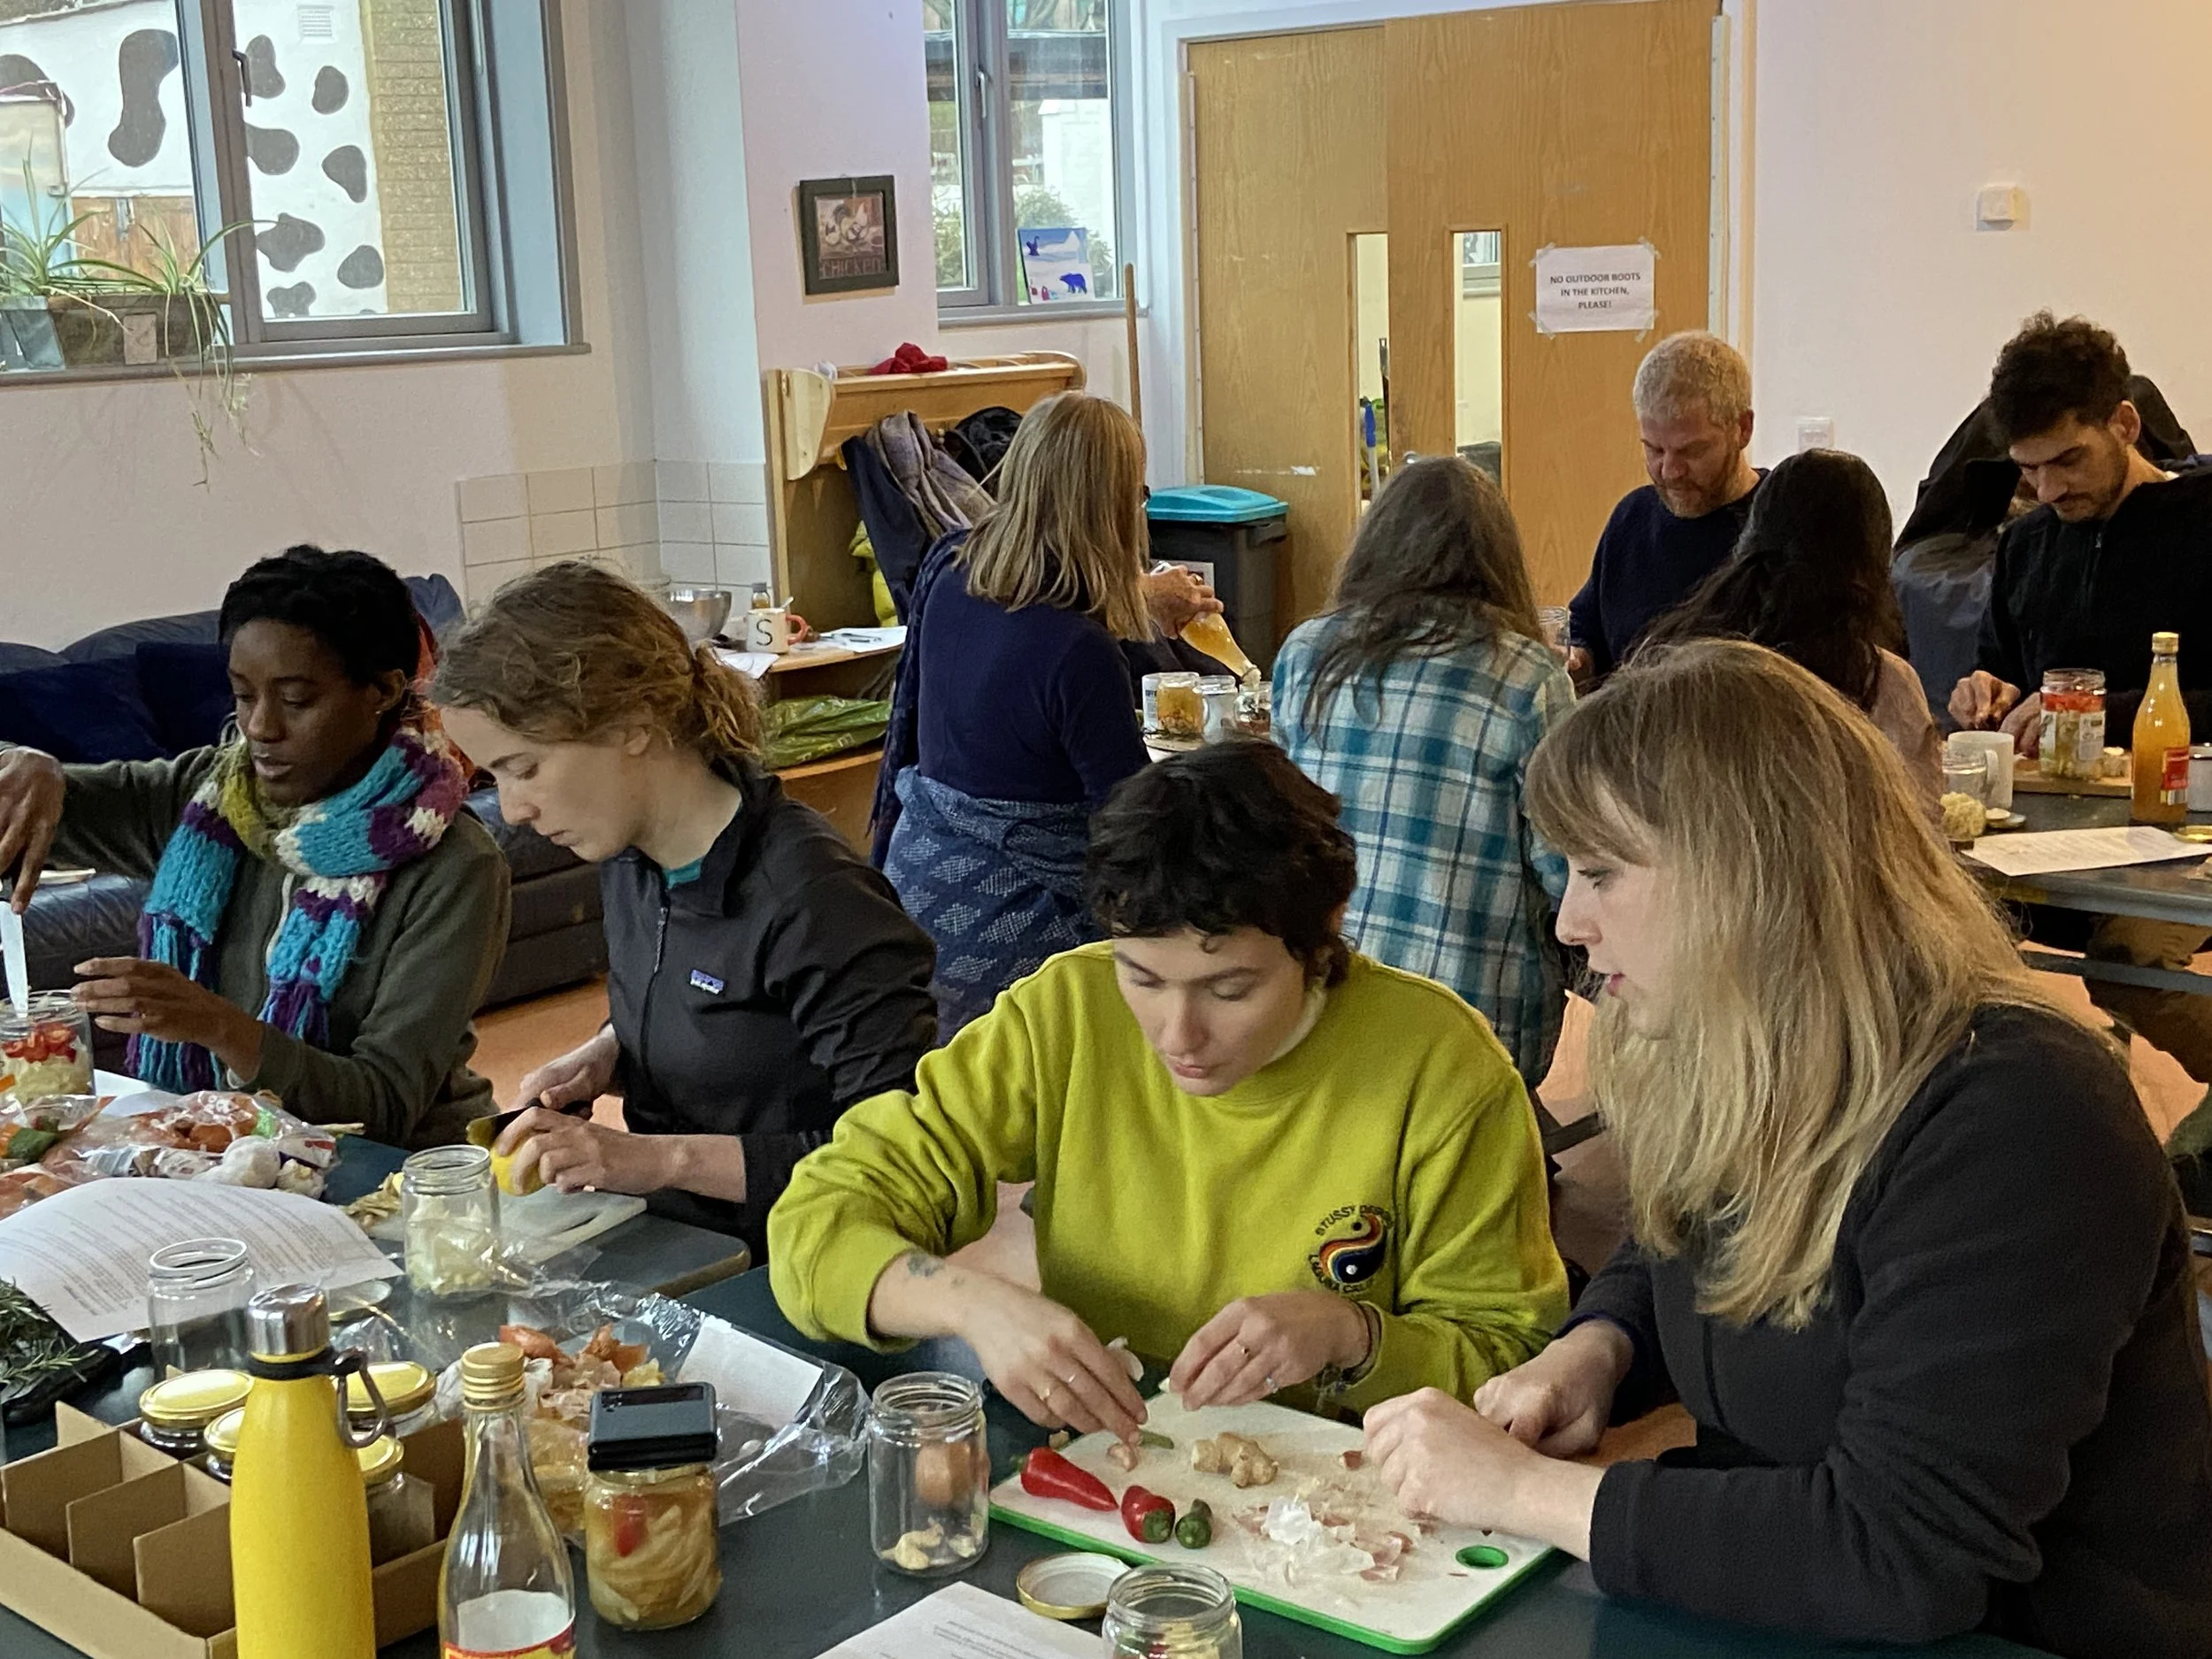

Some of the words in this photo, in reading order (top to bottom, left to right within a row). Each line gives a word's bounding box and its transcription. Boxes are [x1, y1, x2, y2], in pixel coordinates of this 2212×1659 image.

[1550, 275, 1563, 284] NO
[1565, 274, 1610, 283] OUTDOOR
[1611, 273, 1641, 281] BOOTS
[1572, 288, 1589, 296] THE
[1591, 287, 1630, 296] KITCHEN,
[1578, 301, 1612, 310] PLEASE!
[756, 618, 773, 647] S
